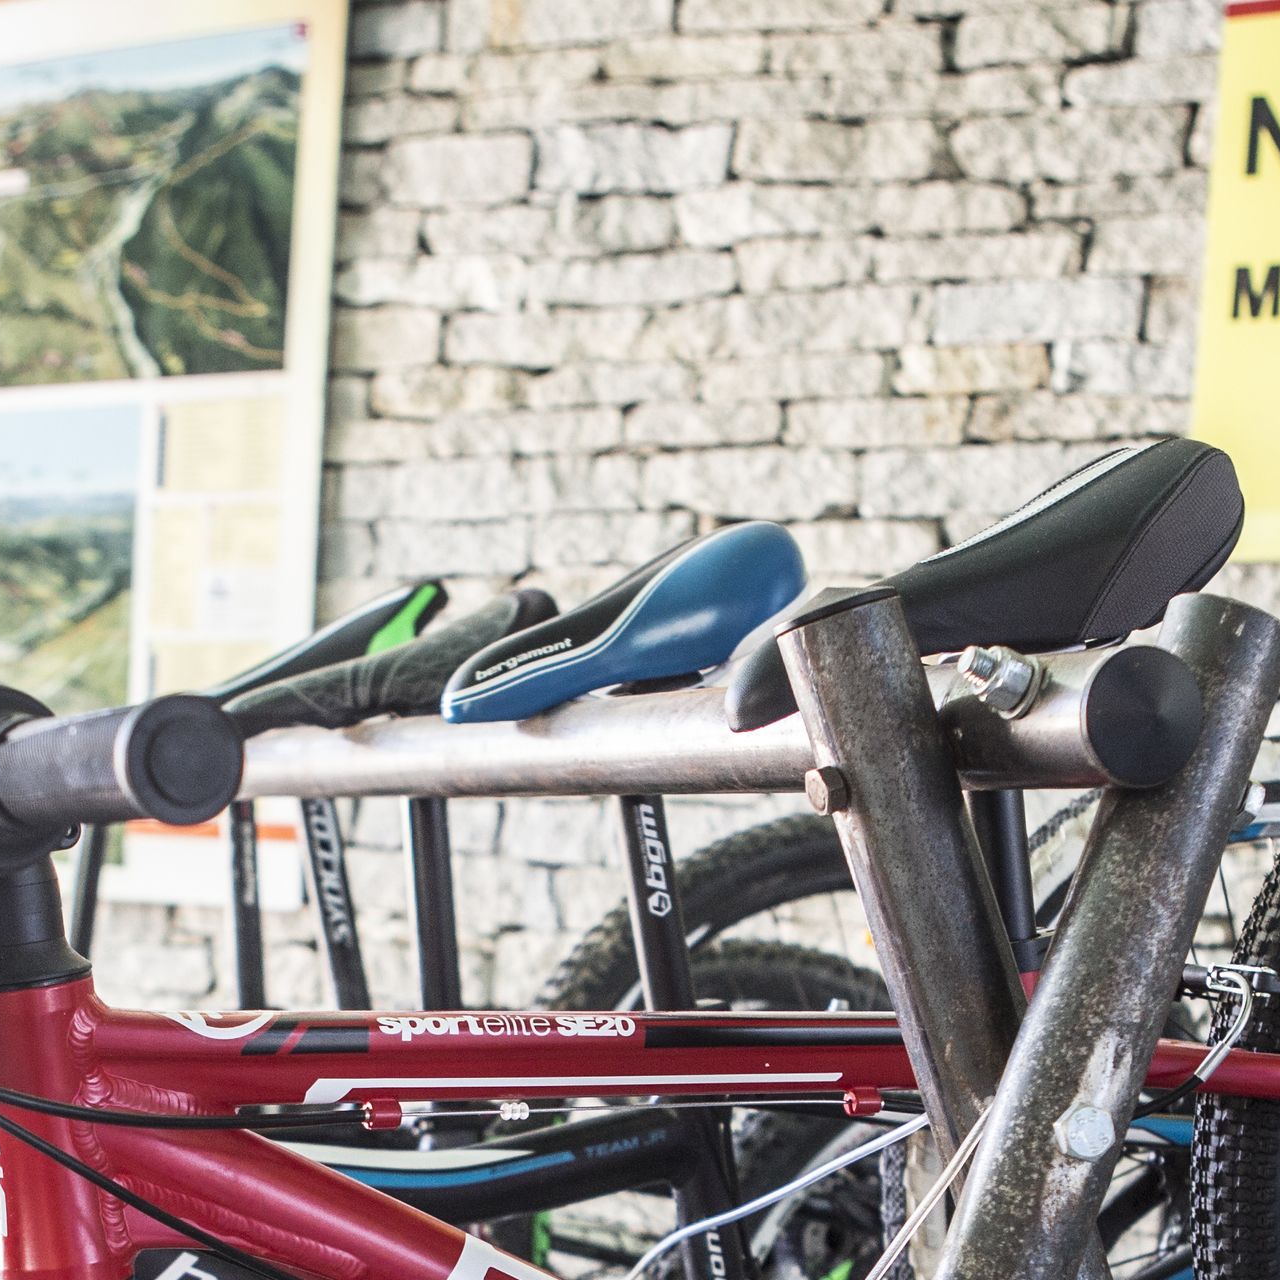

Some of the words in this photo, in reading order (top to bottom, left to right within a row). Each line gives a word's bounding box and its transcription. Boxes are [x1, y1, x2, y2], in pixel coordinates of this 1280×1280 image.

[475, 636, 572, 681] bergamont
[639, 803, 668, 890] bgm
[557, 1016, 636, 1037] SE20
[585, 1136, 640, 1158] TEAM
